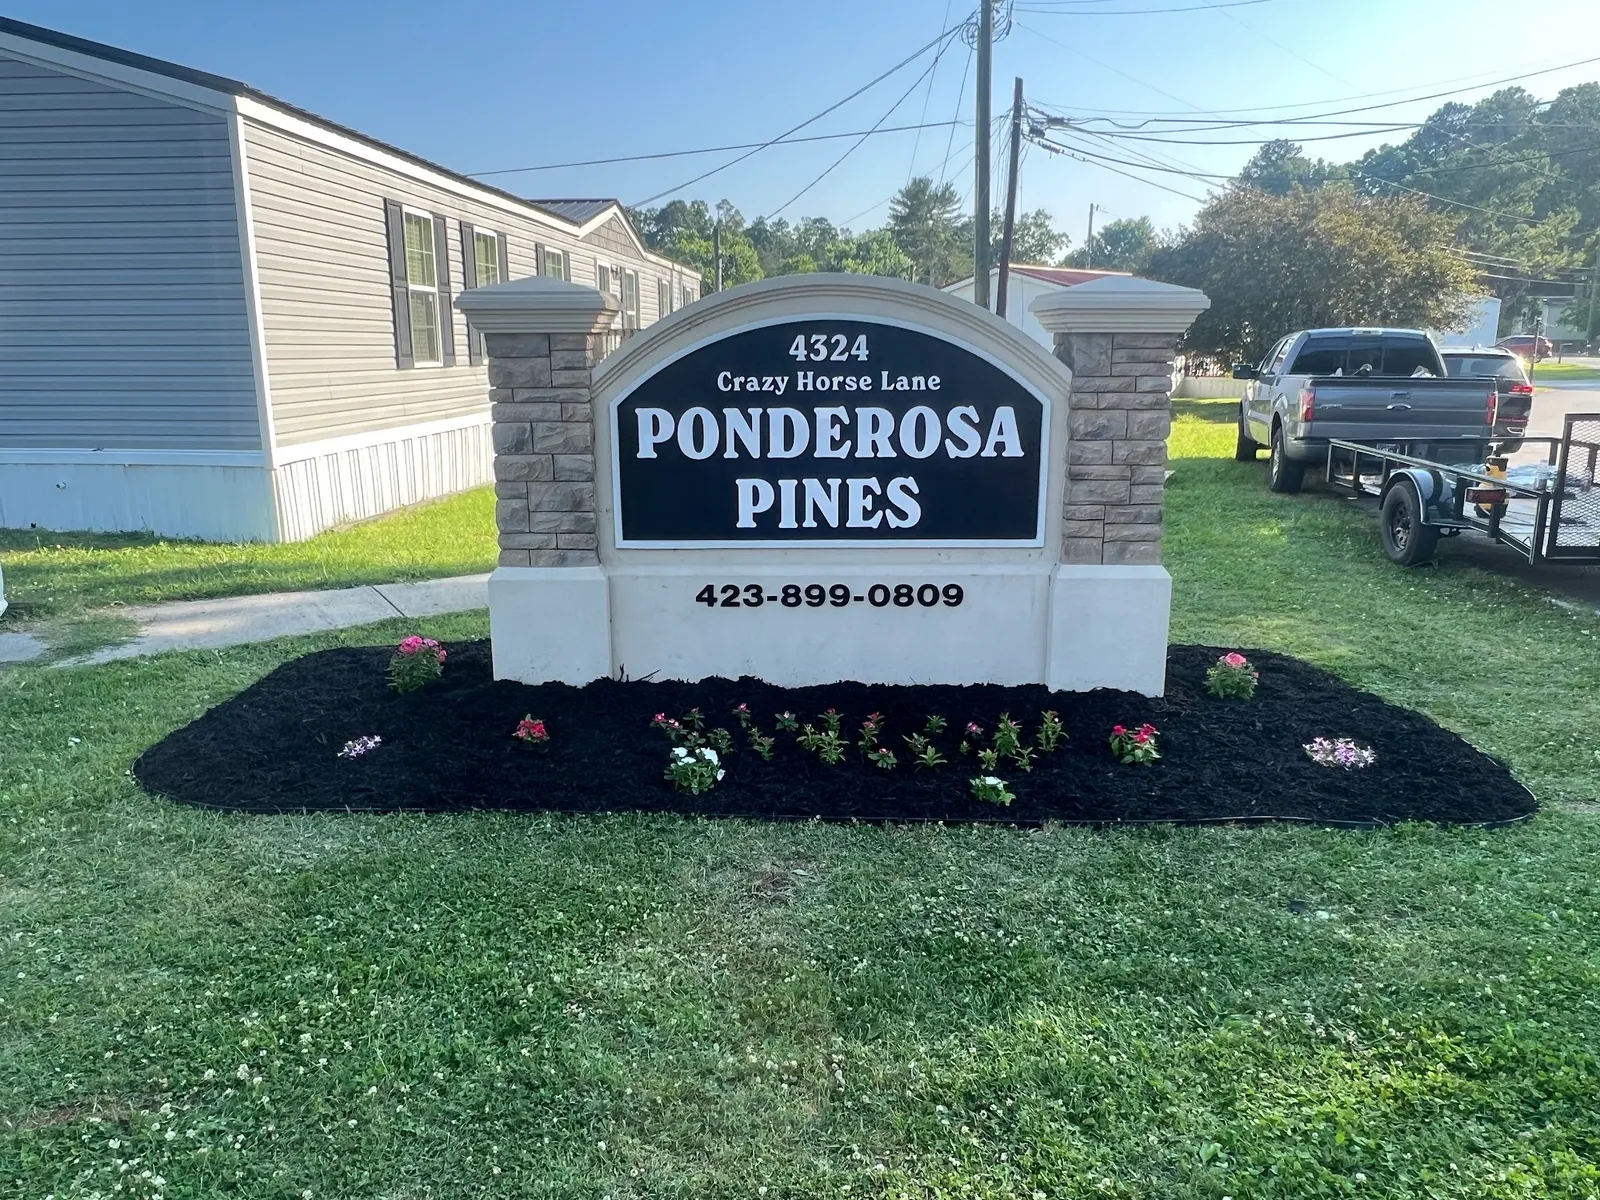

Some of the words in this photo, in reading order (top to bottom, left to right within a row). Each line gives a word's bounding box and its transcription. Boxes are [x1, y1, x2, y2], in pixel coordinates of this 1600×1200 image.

[788, 334, 870, 362] 4324
[717, 371, 789, 396] Crazy
[796, 371, 873, 391] Horse
[881, 371, 941, 391] Lane
[635, 405, 1025, 460] PONDEROSA
[736, 476, 922, 529] PINES
[695, 583, 964, 608] 423-899-0809
